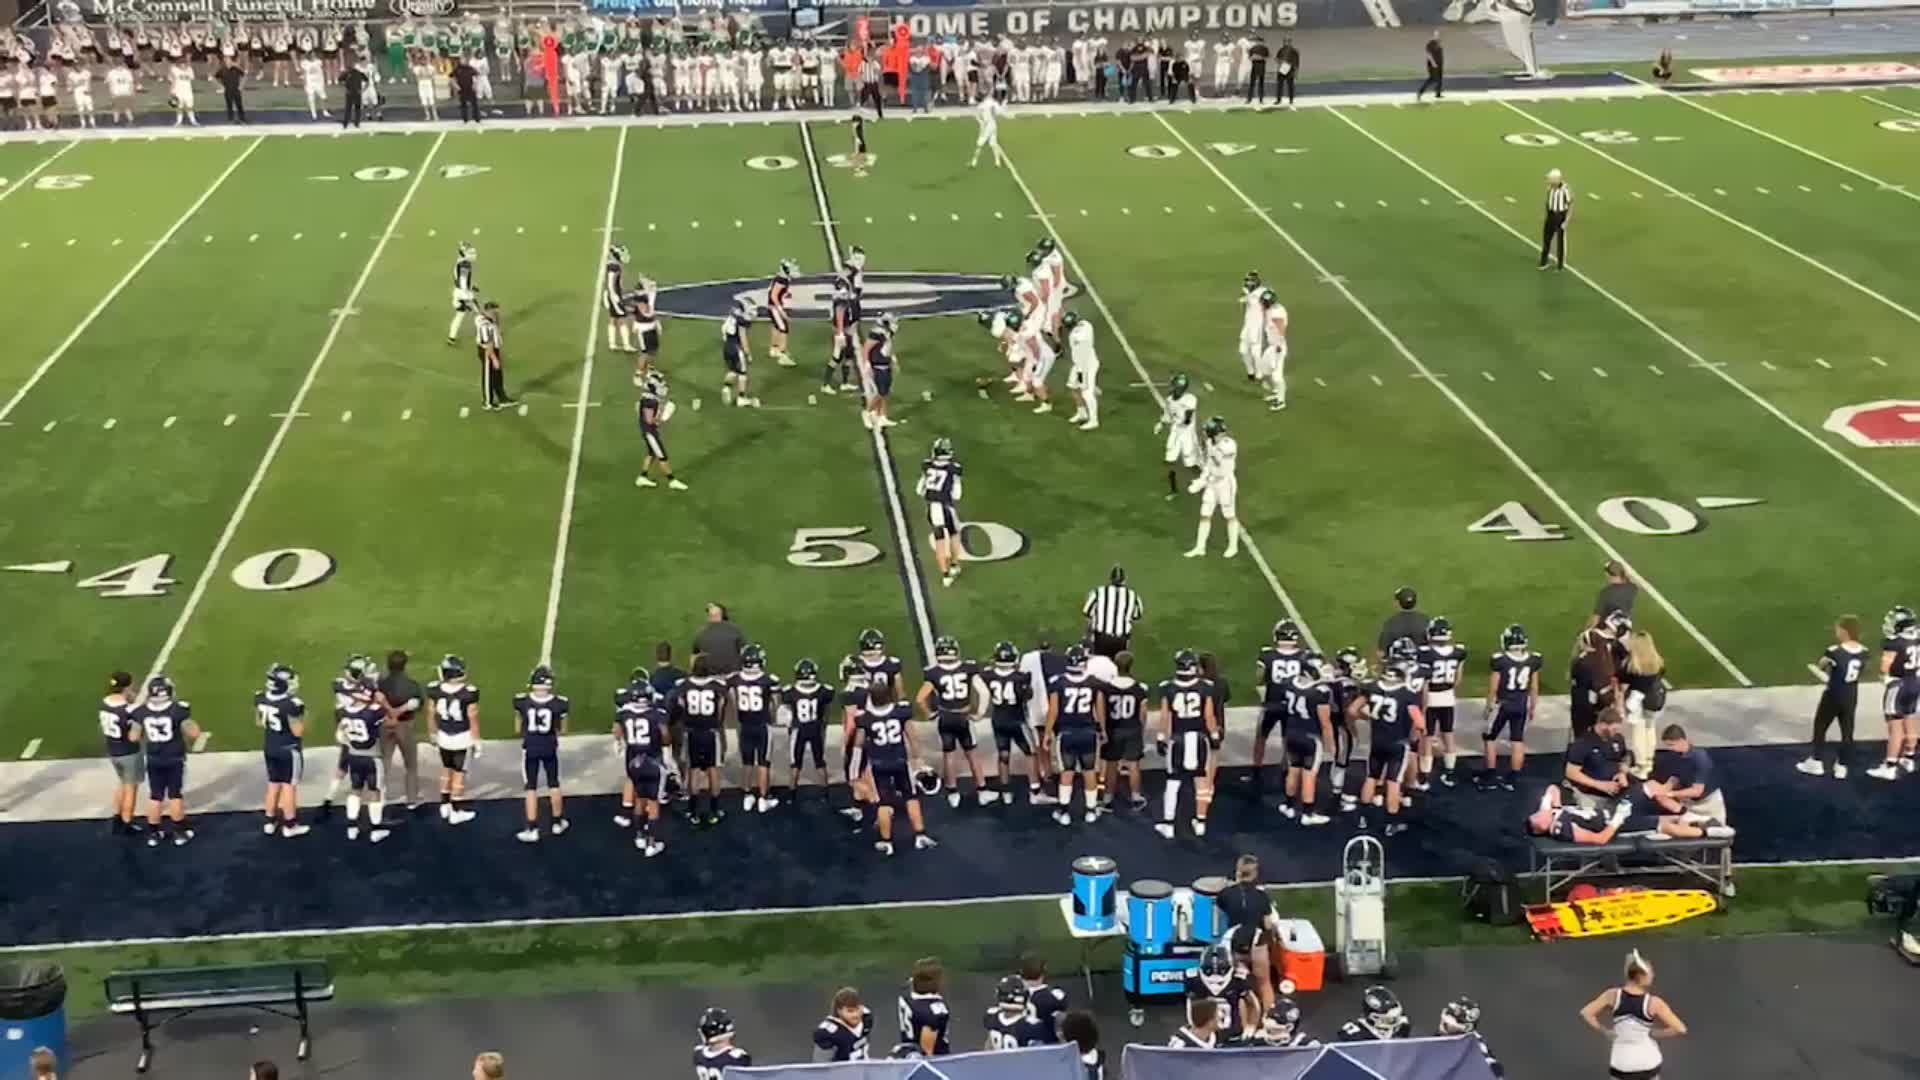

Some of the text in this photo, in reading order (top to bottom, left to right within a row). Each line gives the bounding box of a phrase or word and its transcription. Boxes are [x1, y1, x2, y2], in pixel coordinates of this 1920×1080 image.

[94, 0, 213, 14] McConnell
[1006, 10, 1051, 34] OF
[1067, 3, 1299, 32] CHAMPIONS
[926, 467, 950, 491] 27
[1430, 659, 1458, 684] 26
[1506, 666, 1529, 690] 14
[738, 685, 764, 711] 66
[940, 673, 968, 700] 35
[989, 680, 1015, 705] 34
[796, 698, 817, 723] 81
[1062, 687, 1090, 714] 72
[1109, 694, 1135, 720] 30
[1170, 691, 1199, 718] 42
[1284, 690, 1309, 720] 74
[1370, 694, 1397, 723] 73
[143, 715, 171, 743] 63
[527, 707, 552, 734] 13
[624, 718, 650, 745] 12
[870, 719, 900, 747] 32
